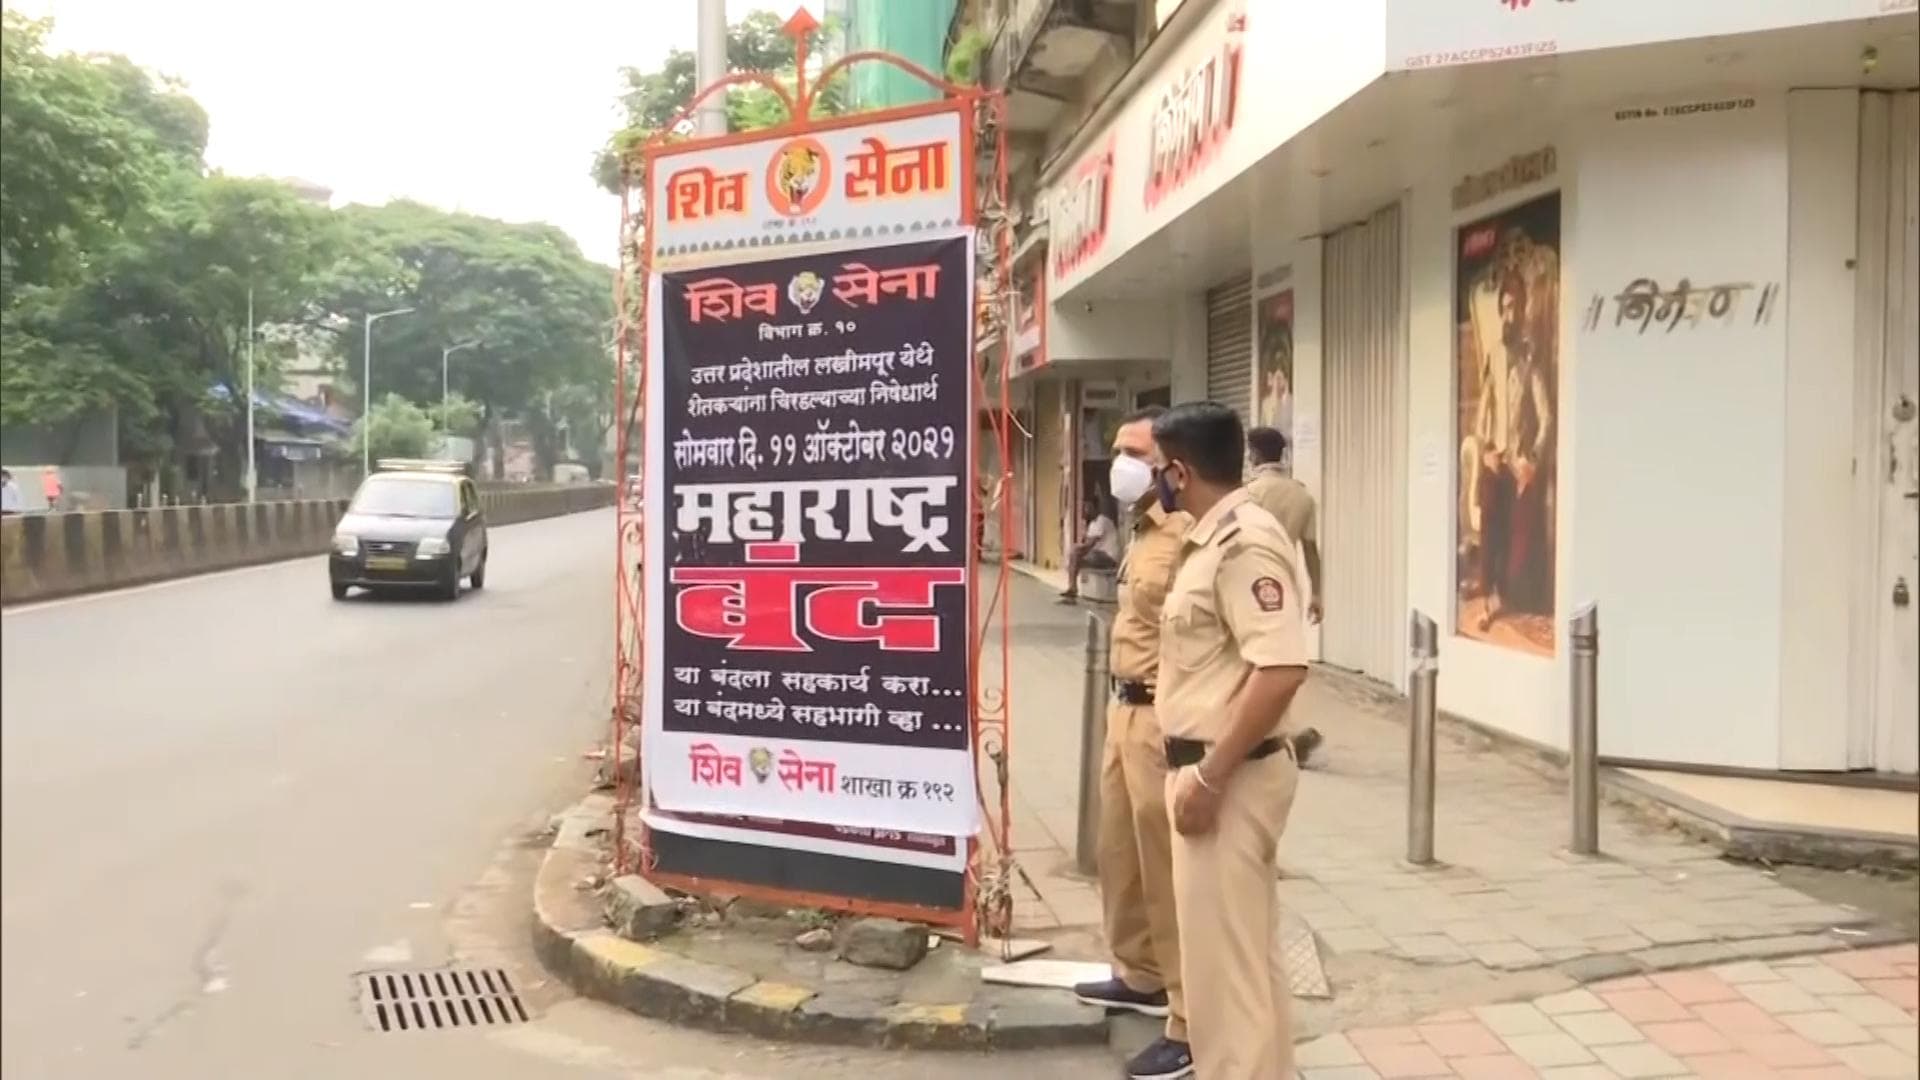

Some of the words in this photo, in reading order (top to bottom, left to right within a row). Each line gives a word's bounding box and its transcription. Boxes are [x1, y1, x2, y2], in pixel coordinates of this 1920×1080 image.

[667, 166, 748, 220] शिव
[845, 137, 948, 198] सेना
[684, 277, 777, 323] शिव
[832, 262, 941, 308] सेना
[759, 322, 802, 341] विभाग
[835, 321, 856, 334] १०
[691, 365, 724, 384] उत्तर
[730, 355, 809, 384] प्रदेशातील
[900, 342, 935, 366] येथे
[871, 374, 938, 404] निषेधार्थ
[674, 429, 734, 469] सोमवार
[770, 433, 796, 466] ११
[892, 424, 954, 458] २०२१
[673, 476, 957, 552] महाराष्ट्र
[671, 543, 965, 651] बंद
[674, 667, 699, 684] या
[710, 659, 771, 690] बंदला
[782, 665, 871, 692] सहकार्य
[674, 698, 699, 716] या
[706, 691, 786, 723] बंदमध्ये
[792, 704, 880, 727] सहभागी
[888, 710, 923, 732] व्हा
[689, 743, 742, 788] शिव
[778, 749, 836, 794] सेना
[841, 777, 892, 799] शाखा
[897, 782, 917, 800] क्र
